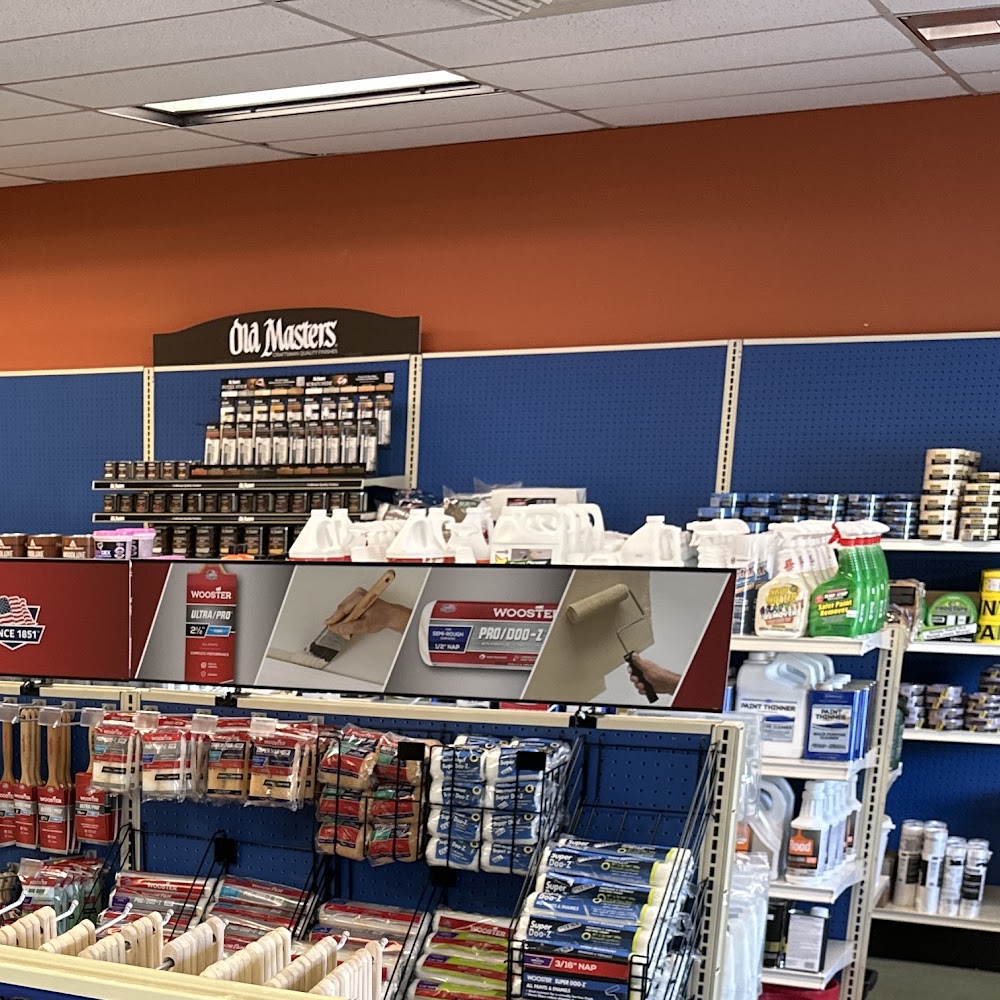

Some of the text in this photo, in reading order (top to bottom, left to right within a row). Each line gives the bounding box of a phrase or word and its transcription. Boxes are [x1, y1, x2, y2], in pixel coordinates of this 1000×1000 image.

[229, 318, 338, 358] Old Masters
[191, 588, 232, 600] WOOSTER
[16, 629, 37, 639] 1851
[549, 860, 572, 868] Doo-Z
[530, 920, 552, 930] Super
[529, 929, 552, 938] Doo-Z
[578, 963, 597, 971] NAP
